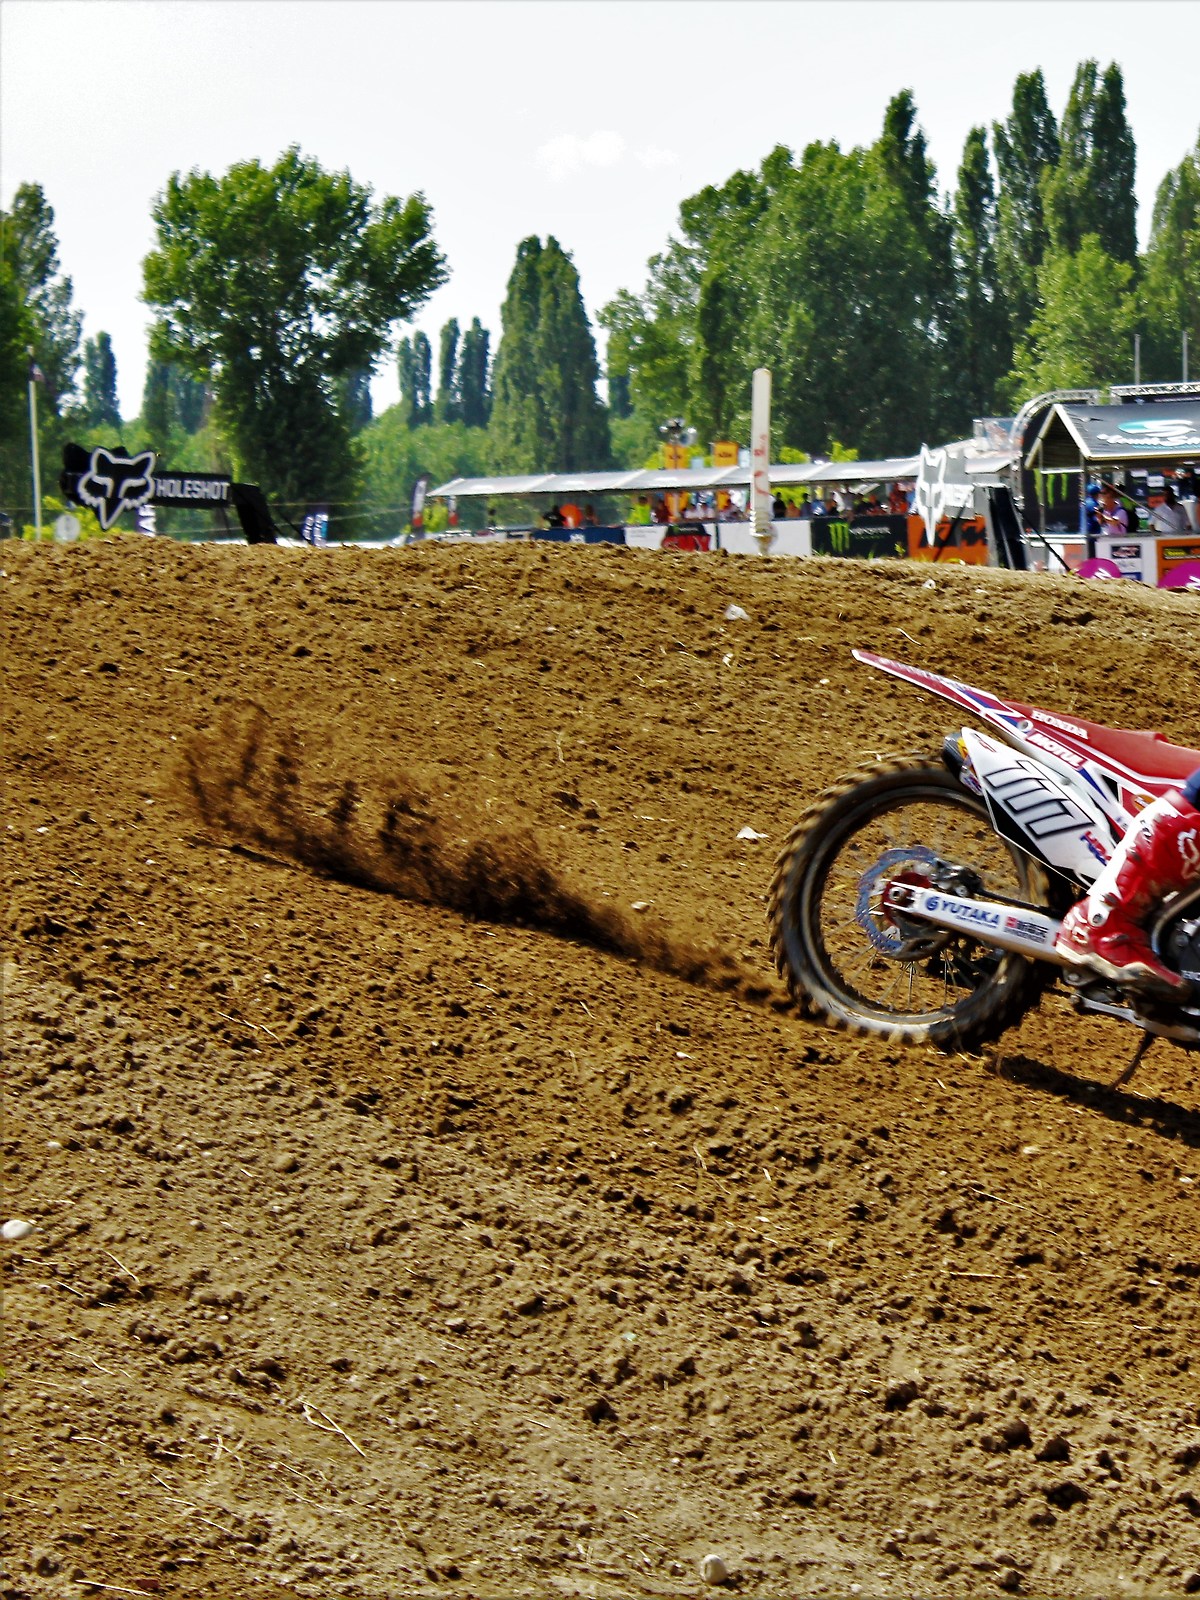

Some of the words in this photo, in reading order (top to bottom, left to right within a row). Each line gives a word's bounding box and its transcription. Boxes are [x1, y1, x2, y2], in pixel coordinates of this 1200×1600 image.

[156, 478, 231, 501] HOLESHOT
[1032, 710, 1089, 740] HONDA
[1030, 731, 1087, 768] MOTUL
[983, 759, 1096, 840] 777
[941, 900, 1000, 925] YUTAKA
